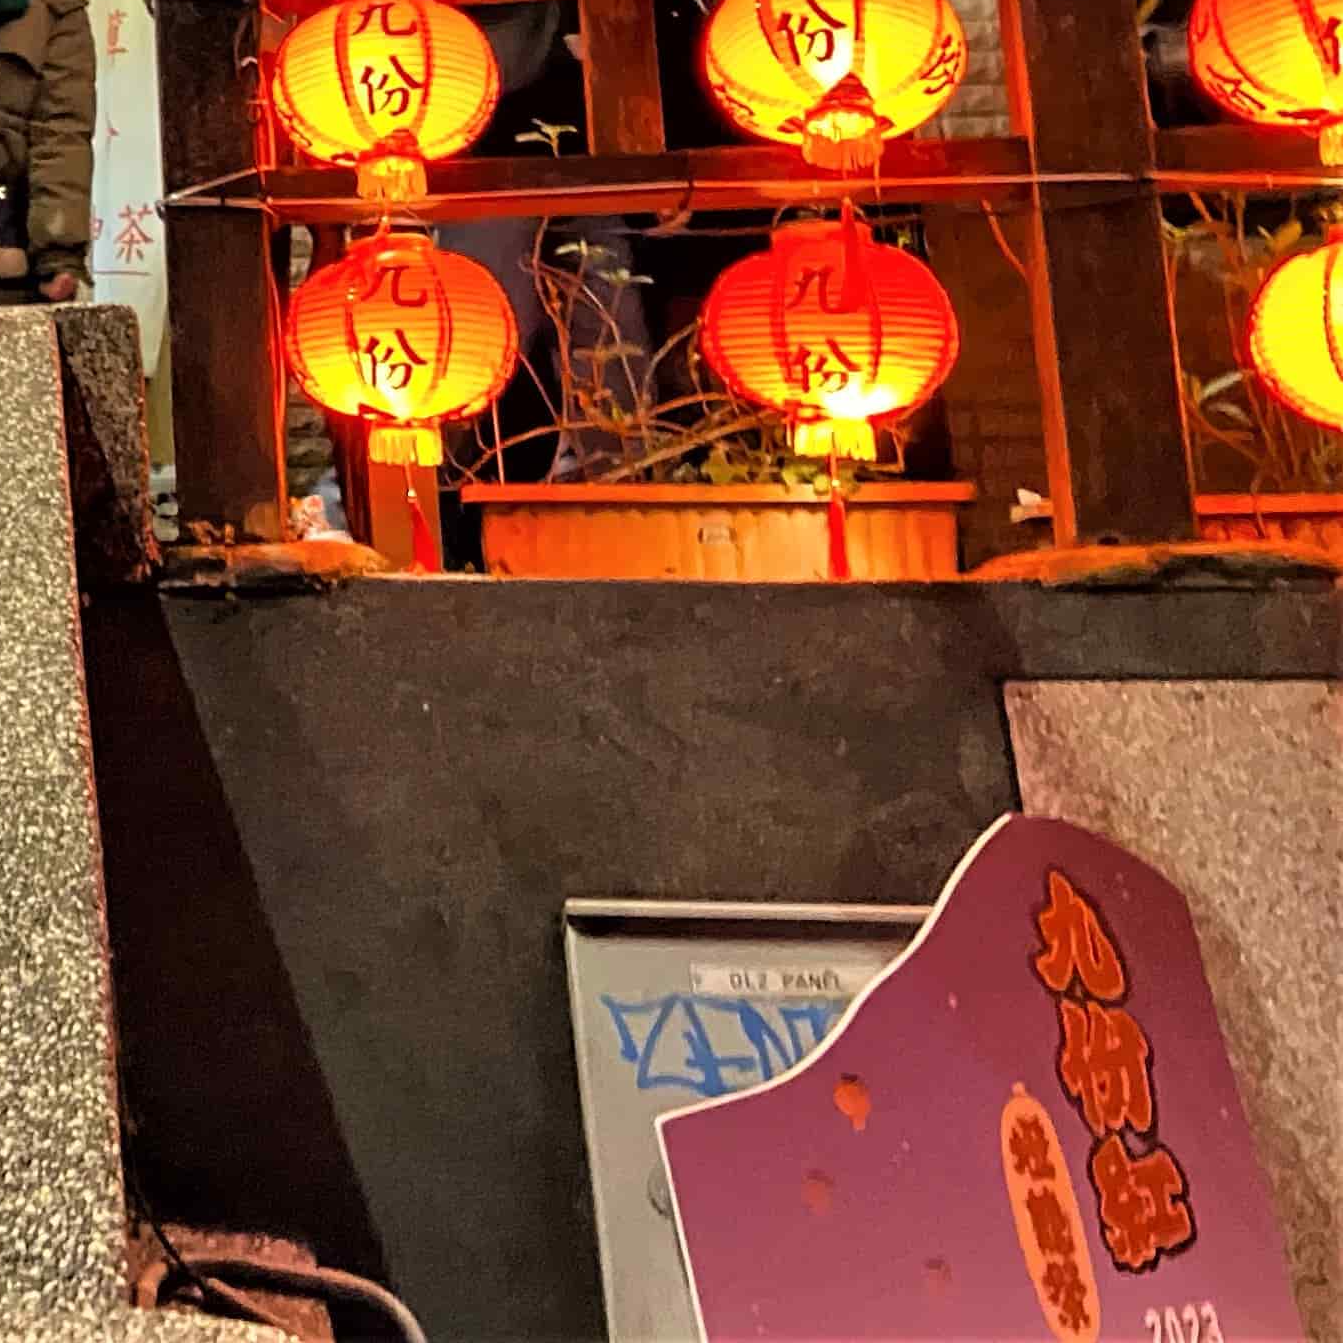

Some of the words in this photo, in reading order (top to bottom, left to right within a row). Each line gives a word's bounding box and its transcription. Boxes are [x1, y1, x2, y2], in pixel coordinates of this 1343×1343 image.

[353, 0, 425, 117] 九份
[359, 264, 429, 393] 九份
[787, 265, 861, 394] 九份
